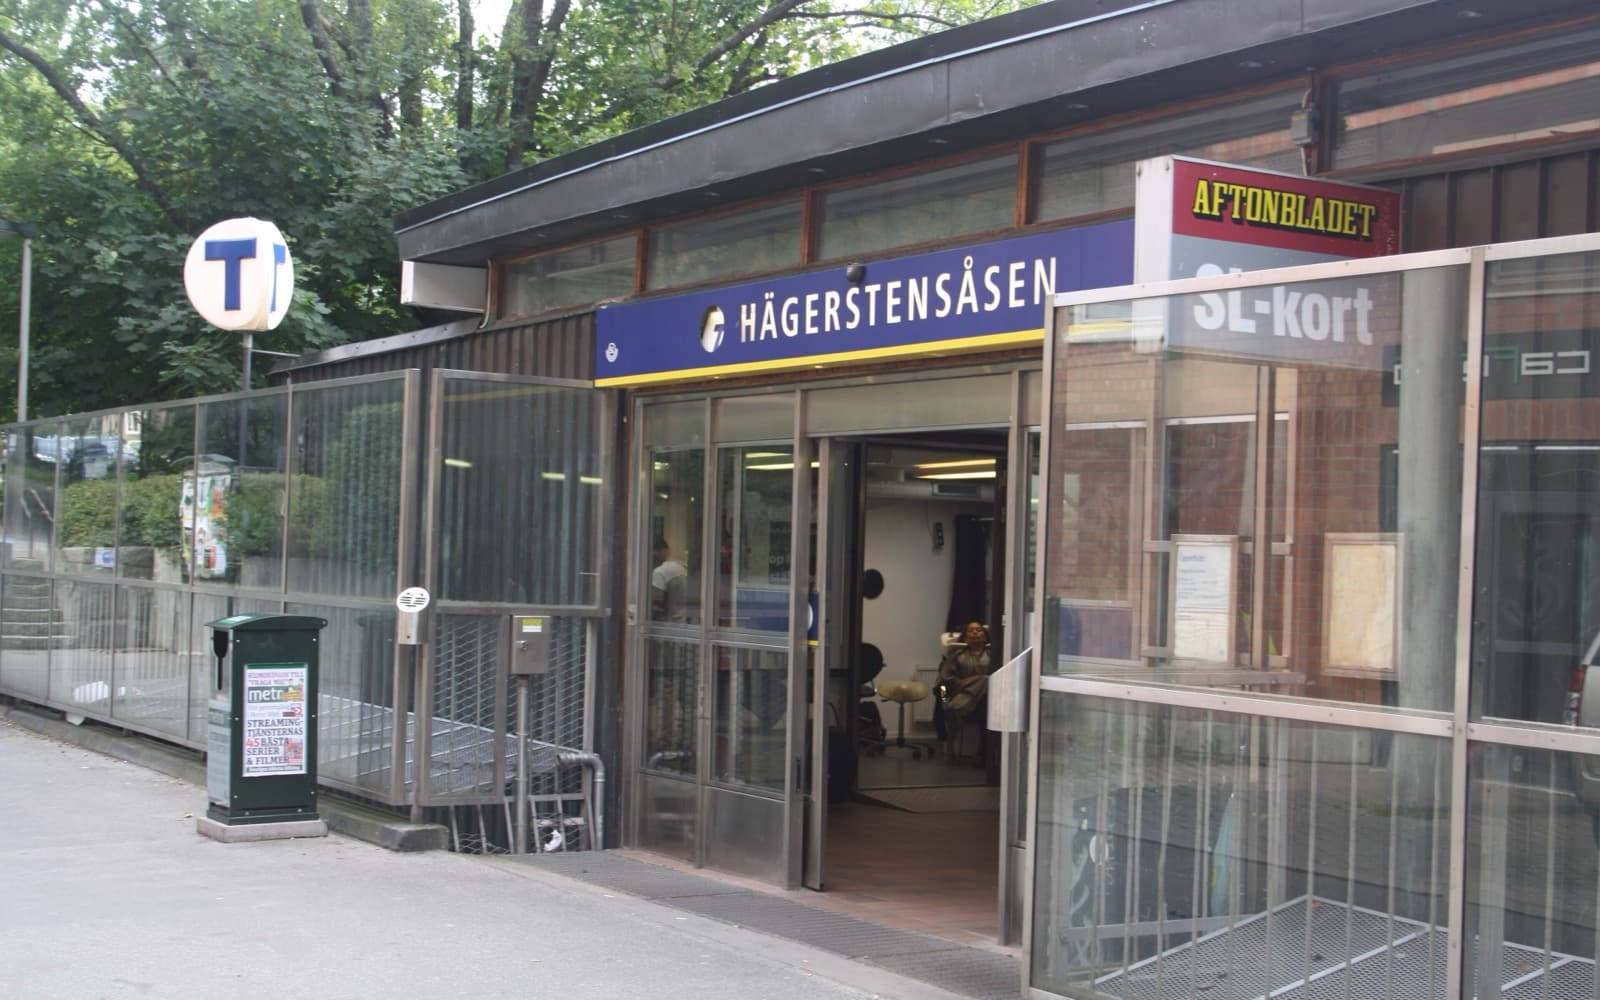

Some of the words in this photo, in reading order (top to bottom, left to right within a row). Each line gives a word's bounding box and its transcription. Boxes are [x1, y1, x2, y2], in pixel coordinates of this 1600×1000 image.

[1192, 179, 1378, 240] AFTONBLADET
[205, 238, 257, 311] T
[740, 256, 1057, 343] HÄGERSTENSÅSEN
[1193, 263, 1374, 345] SL-kort
[248, 718, 304, 728] STREAMING-
[248, 727, 304, 737] TJÄNSTERNAS
[247, 738, 260, 747] 45
[247, 747, 280, 756] SERIER
